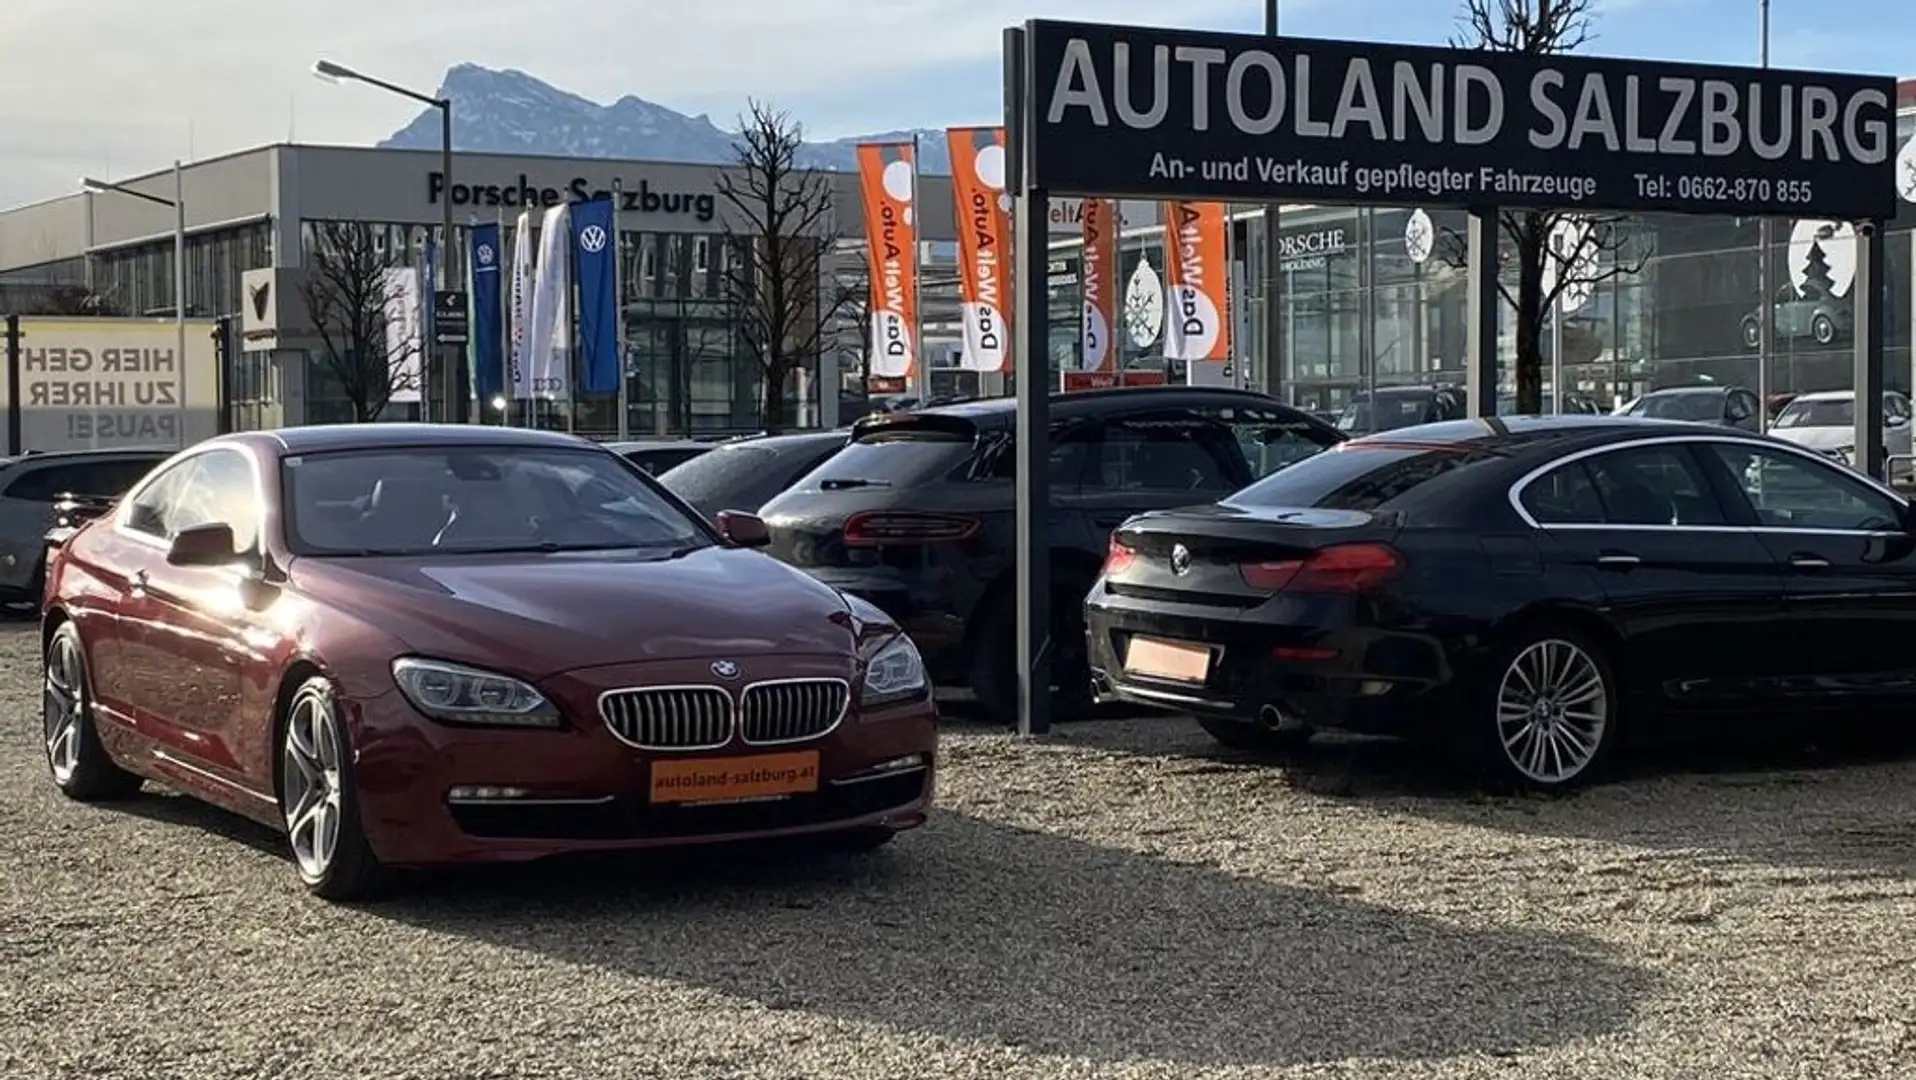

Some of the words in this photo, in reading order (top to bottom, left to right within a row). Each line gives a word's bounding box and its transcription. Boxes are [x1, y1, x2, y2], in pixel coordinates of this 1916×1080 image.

[1047, 38, 1504, 145] AUTOLAND
[1528, 68, 1888, 164] SALZBURG
[427, 171, 560, 207] Porsche
[569, 177, 715, 222] Szburg
[1149, 152, 1194, 180] An-
[1202, 157, 1248, 182] und
[1256, 158, 1350, 187] Verkauf
[1355, 163, 1473, 196] gepflegter
[1479, 168, 1597, 200] Fahrzeuge
[1634, 174, 1672, 198] Tel:
[1678, 175, 1771, 202] 0662-870
[1777, 180, 1813, 203] 855
[655, 764, 815, 789] autoland-salzburg.at
